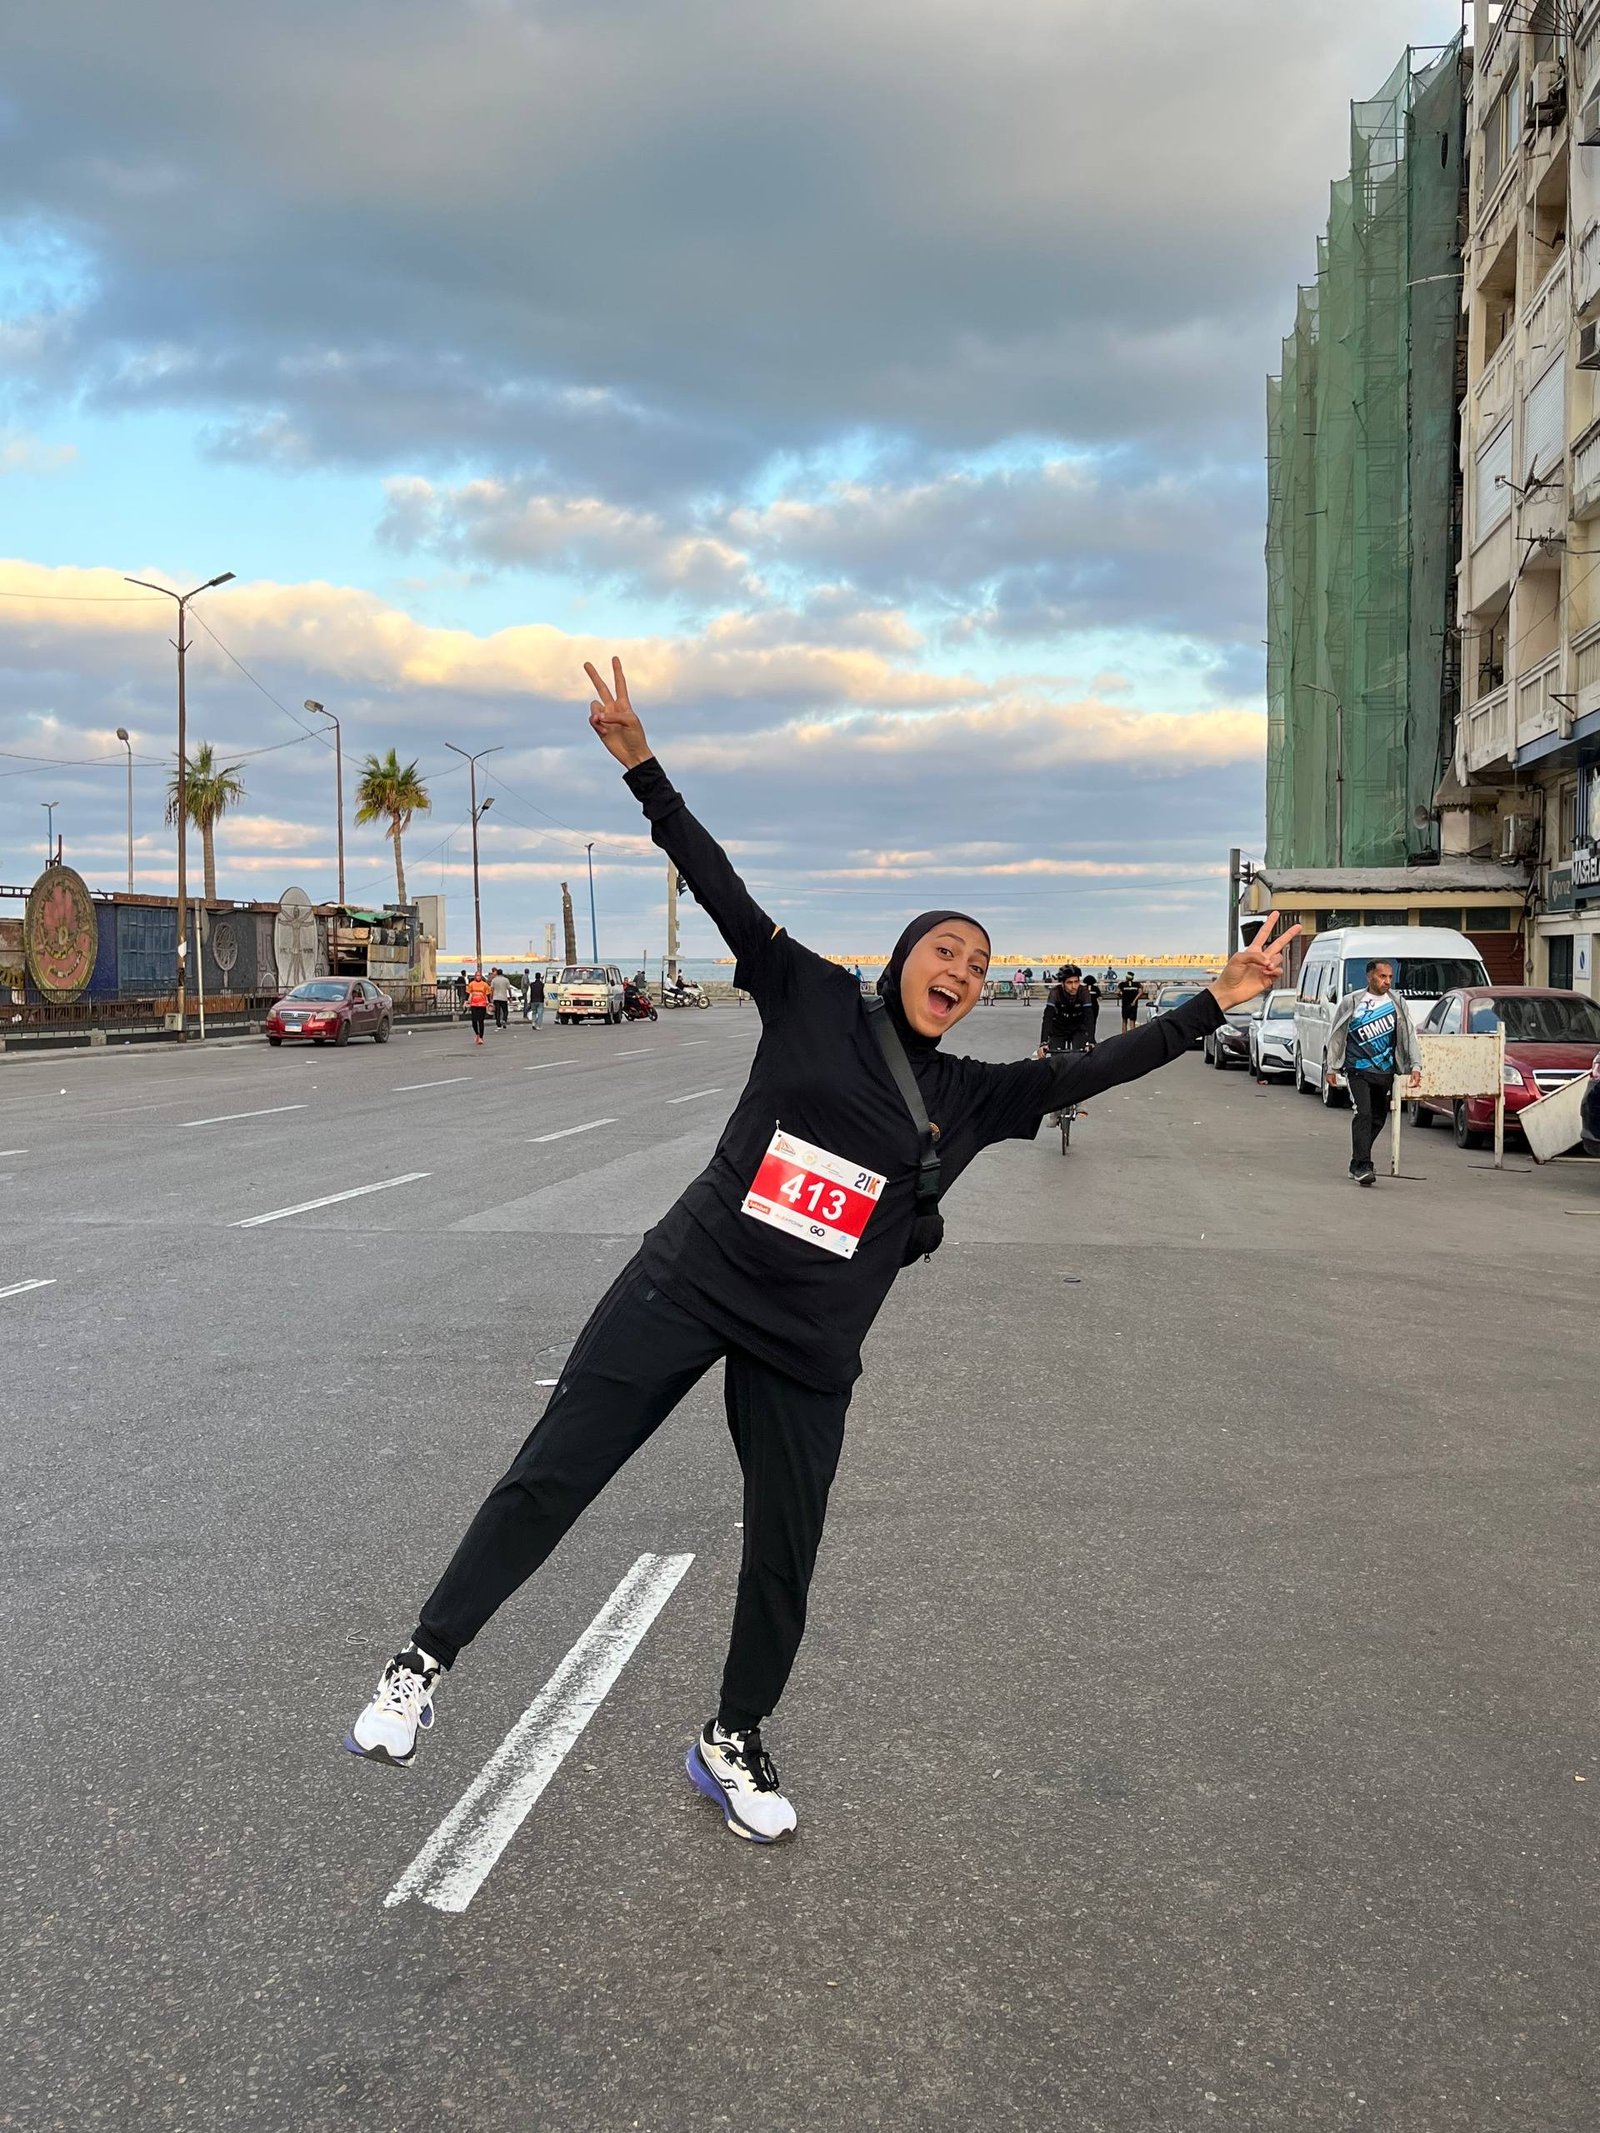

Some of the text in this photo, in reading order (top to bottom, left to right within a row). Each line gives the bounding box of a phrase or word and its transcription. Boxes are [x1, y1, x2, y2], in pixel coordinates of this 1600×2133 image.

[1357, 1014, 1395, 1041] FAMILY
[854, 1172, 880, 1195] 21K
[780, 1173, 847, 1220] 413
[810, 1225, 825, 1237] GO
